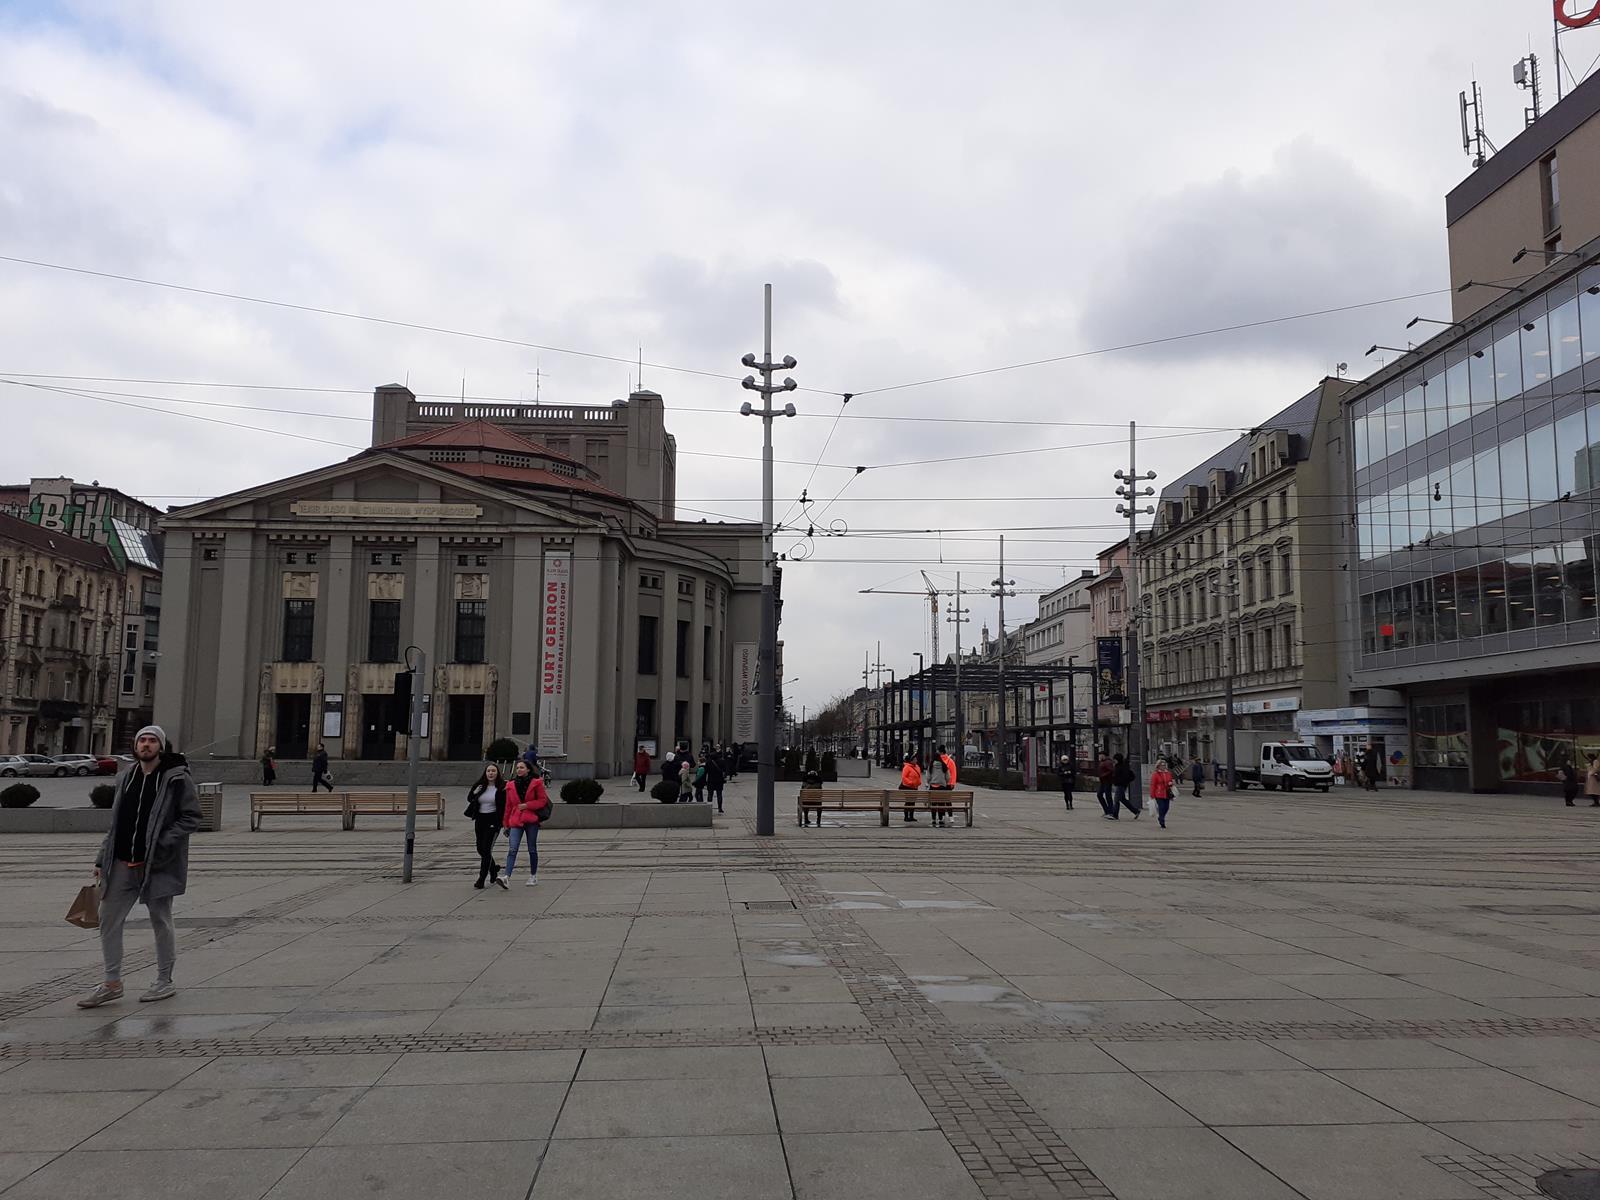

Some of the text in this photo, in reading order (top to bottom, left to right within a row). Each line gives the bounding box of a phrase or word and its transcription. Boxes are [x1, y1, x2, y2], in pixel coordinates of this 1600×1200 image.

[558, 582, 566, 610] ŻYDOM
[545, 582, 558, 647] GERRON
[558, 611, 566, 641] MIASTO
[544, 652, 556, 694] KURT
[555, 663, 563, 694] FÜHRER
